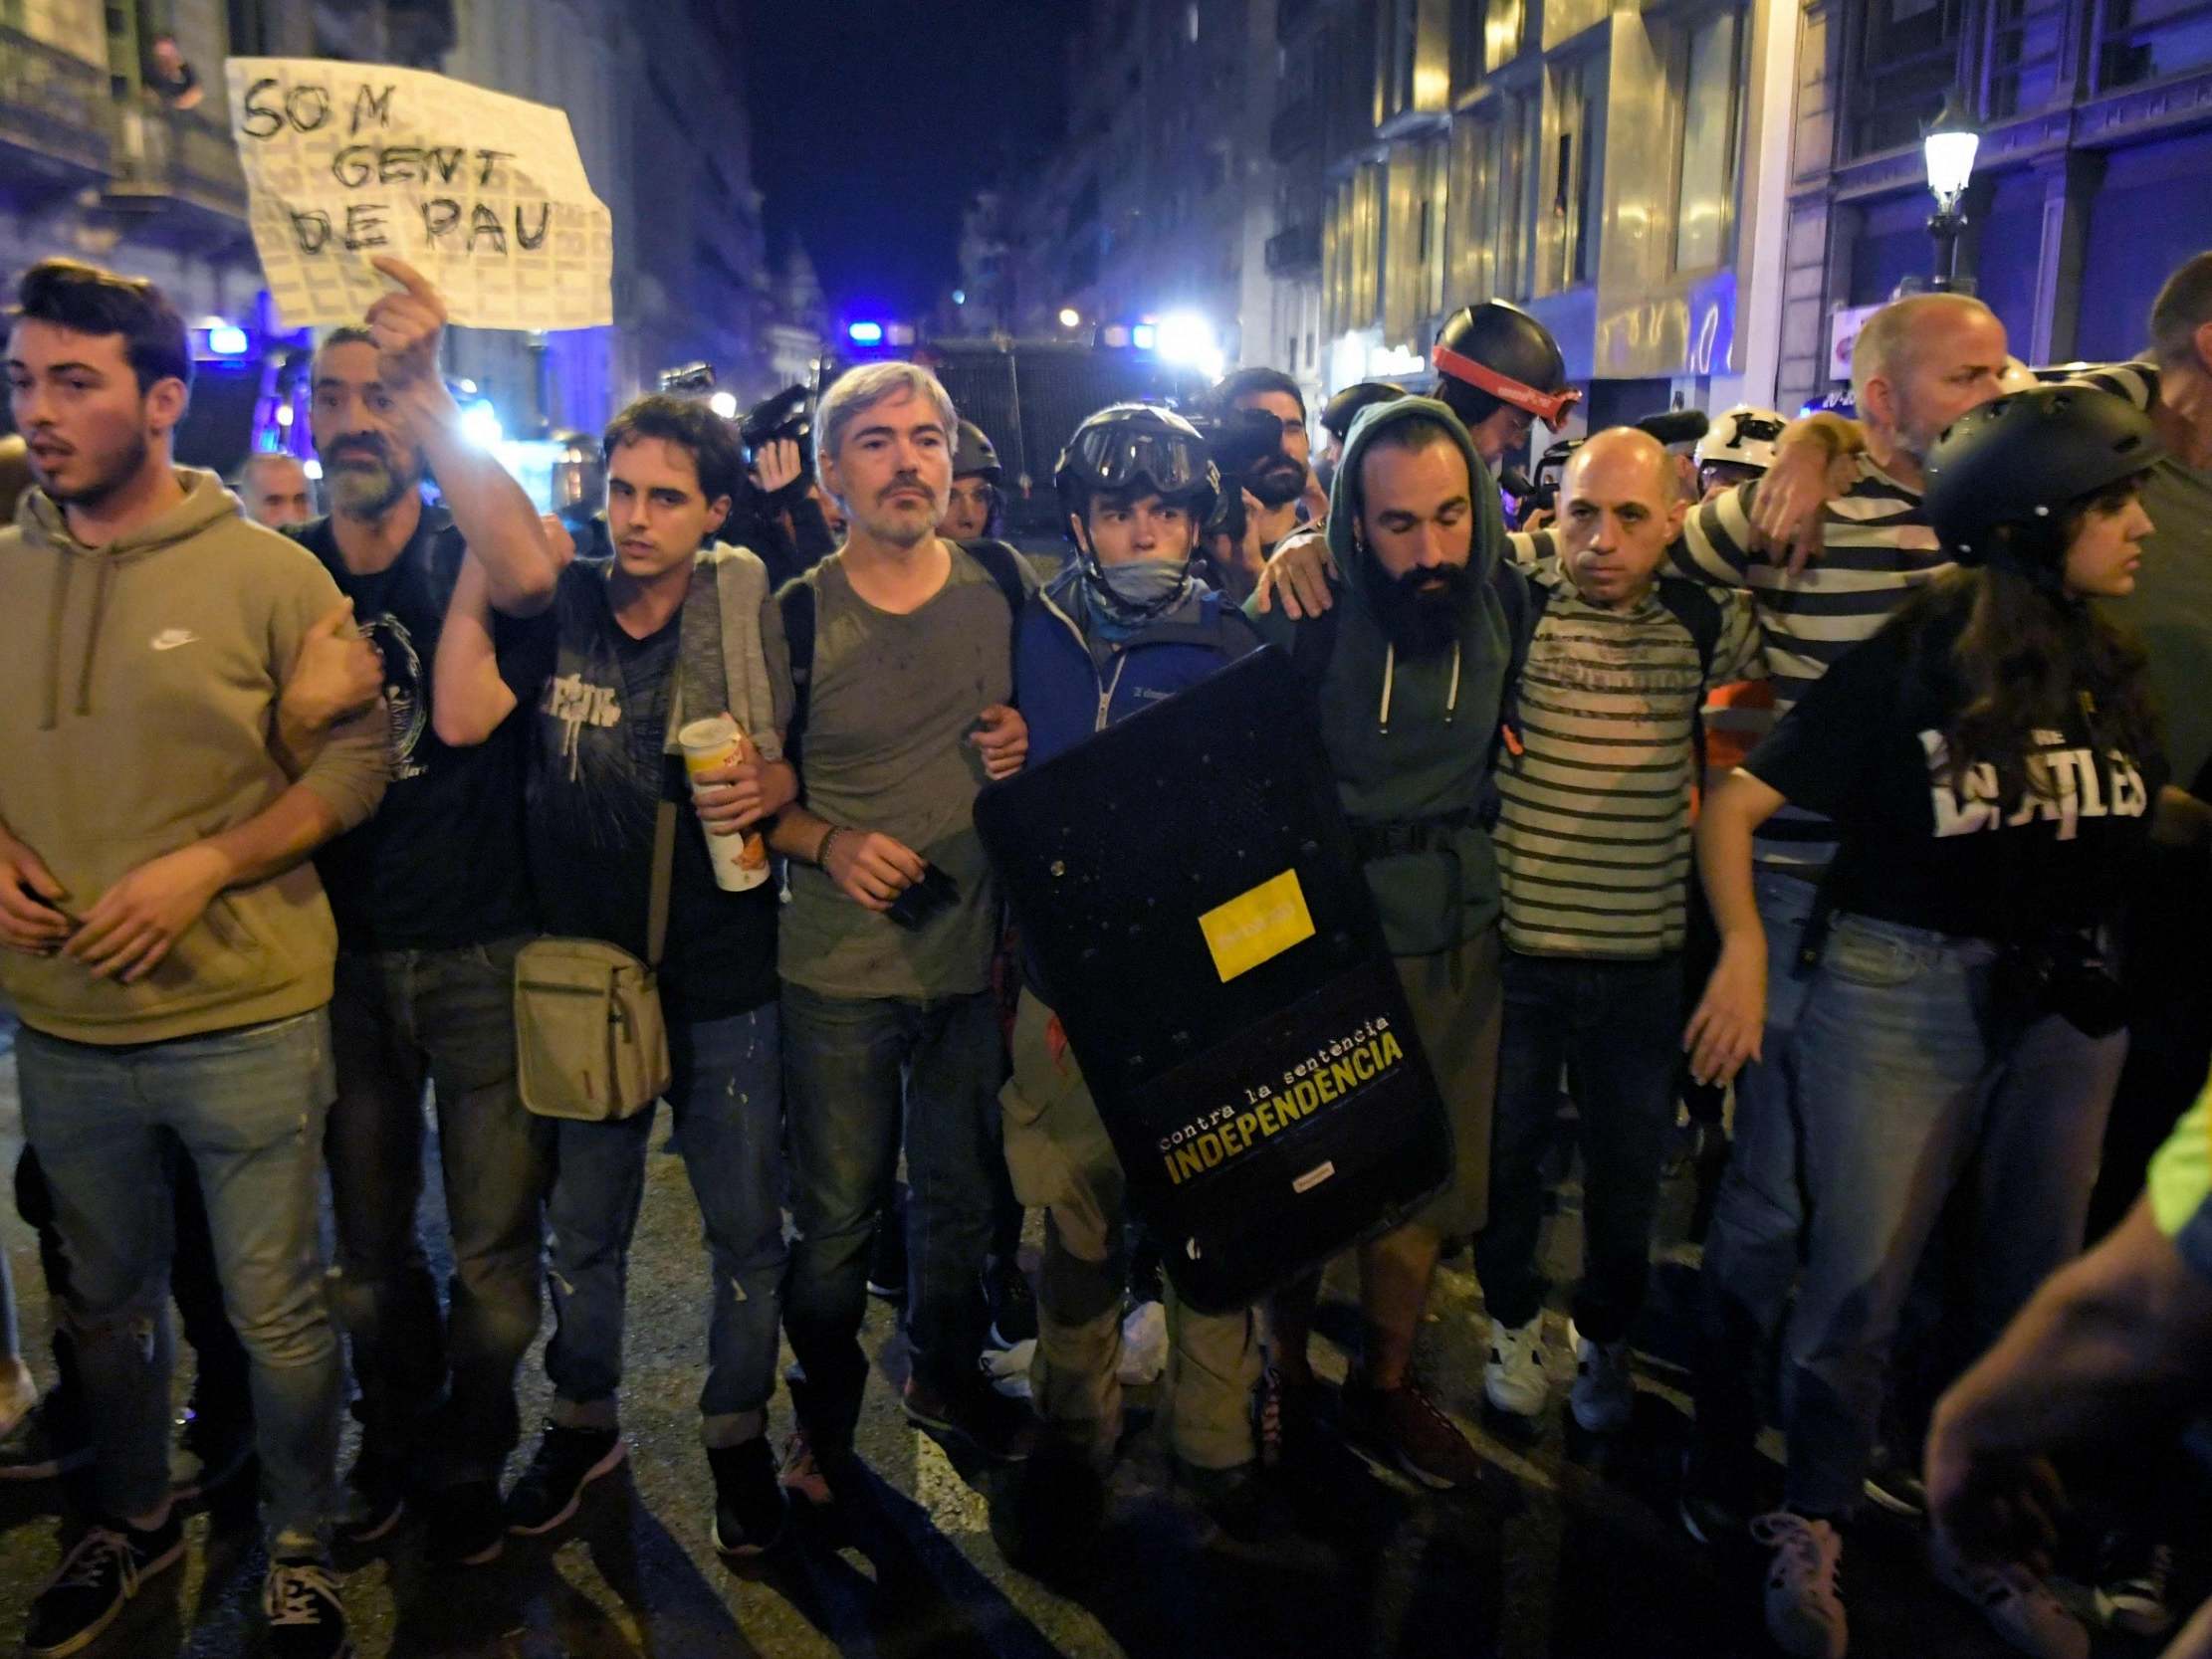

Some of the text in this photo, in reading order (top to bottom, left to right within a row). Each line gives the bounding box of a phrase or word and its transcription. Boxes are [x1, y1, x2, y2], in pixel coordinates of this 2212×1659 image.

[242, 78, 396, 138] SOM
[332, 144, 516, 188] GENT
[290, 198, 551, 257] DE PAU
[1159, 1015, 1390, 1151] contra la sentència
[1163, 1030, 1404, 1185] INDEPENDÈNCIA
